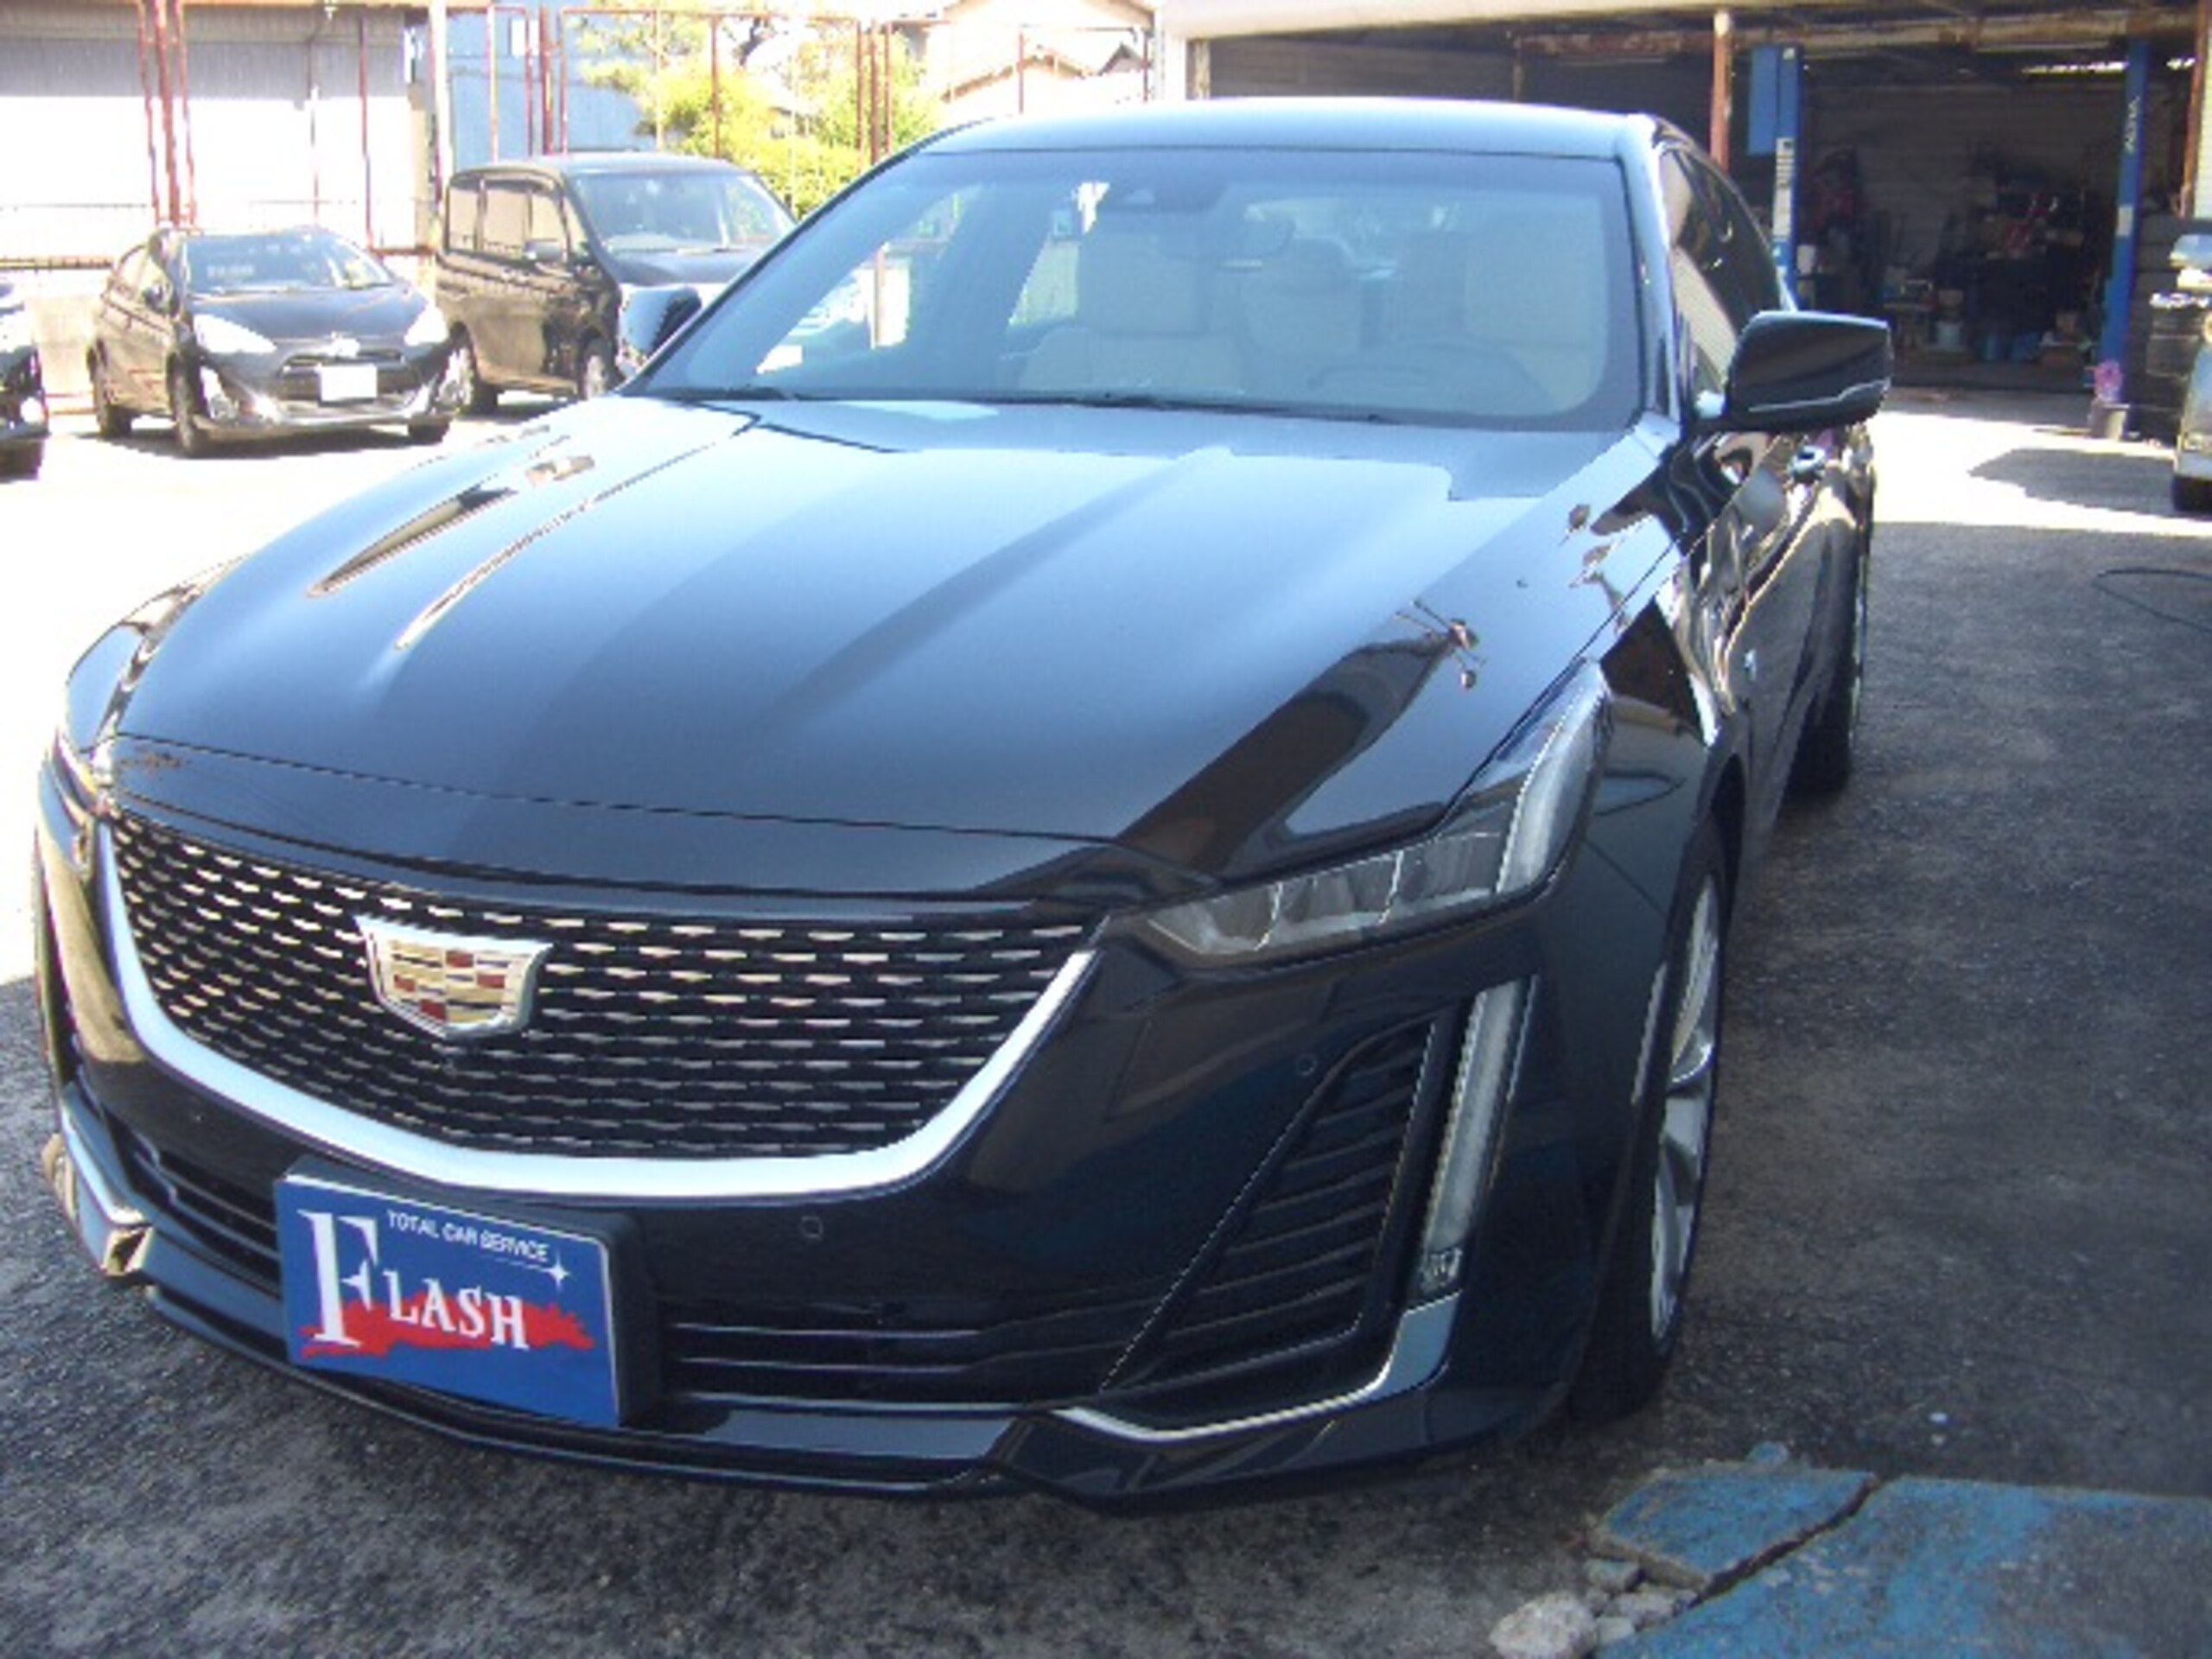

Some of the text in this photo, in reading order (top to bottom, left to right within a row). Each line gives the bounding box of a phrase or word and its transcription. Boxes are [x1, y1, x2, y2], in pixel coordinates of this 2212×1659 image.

[296, 1209, 530, 1351] FLASH
[388, 1210, 550, 1262] TOTAL CAR SERVICE
